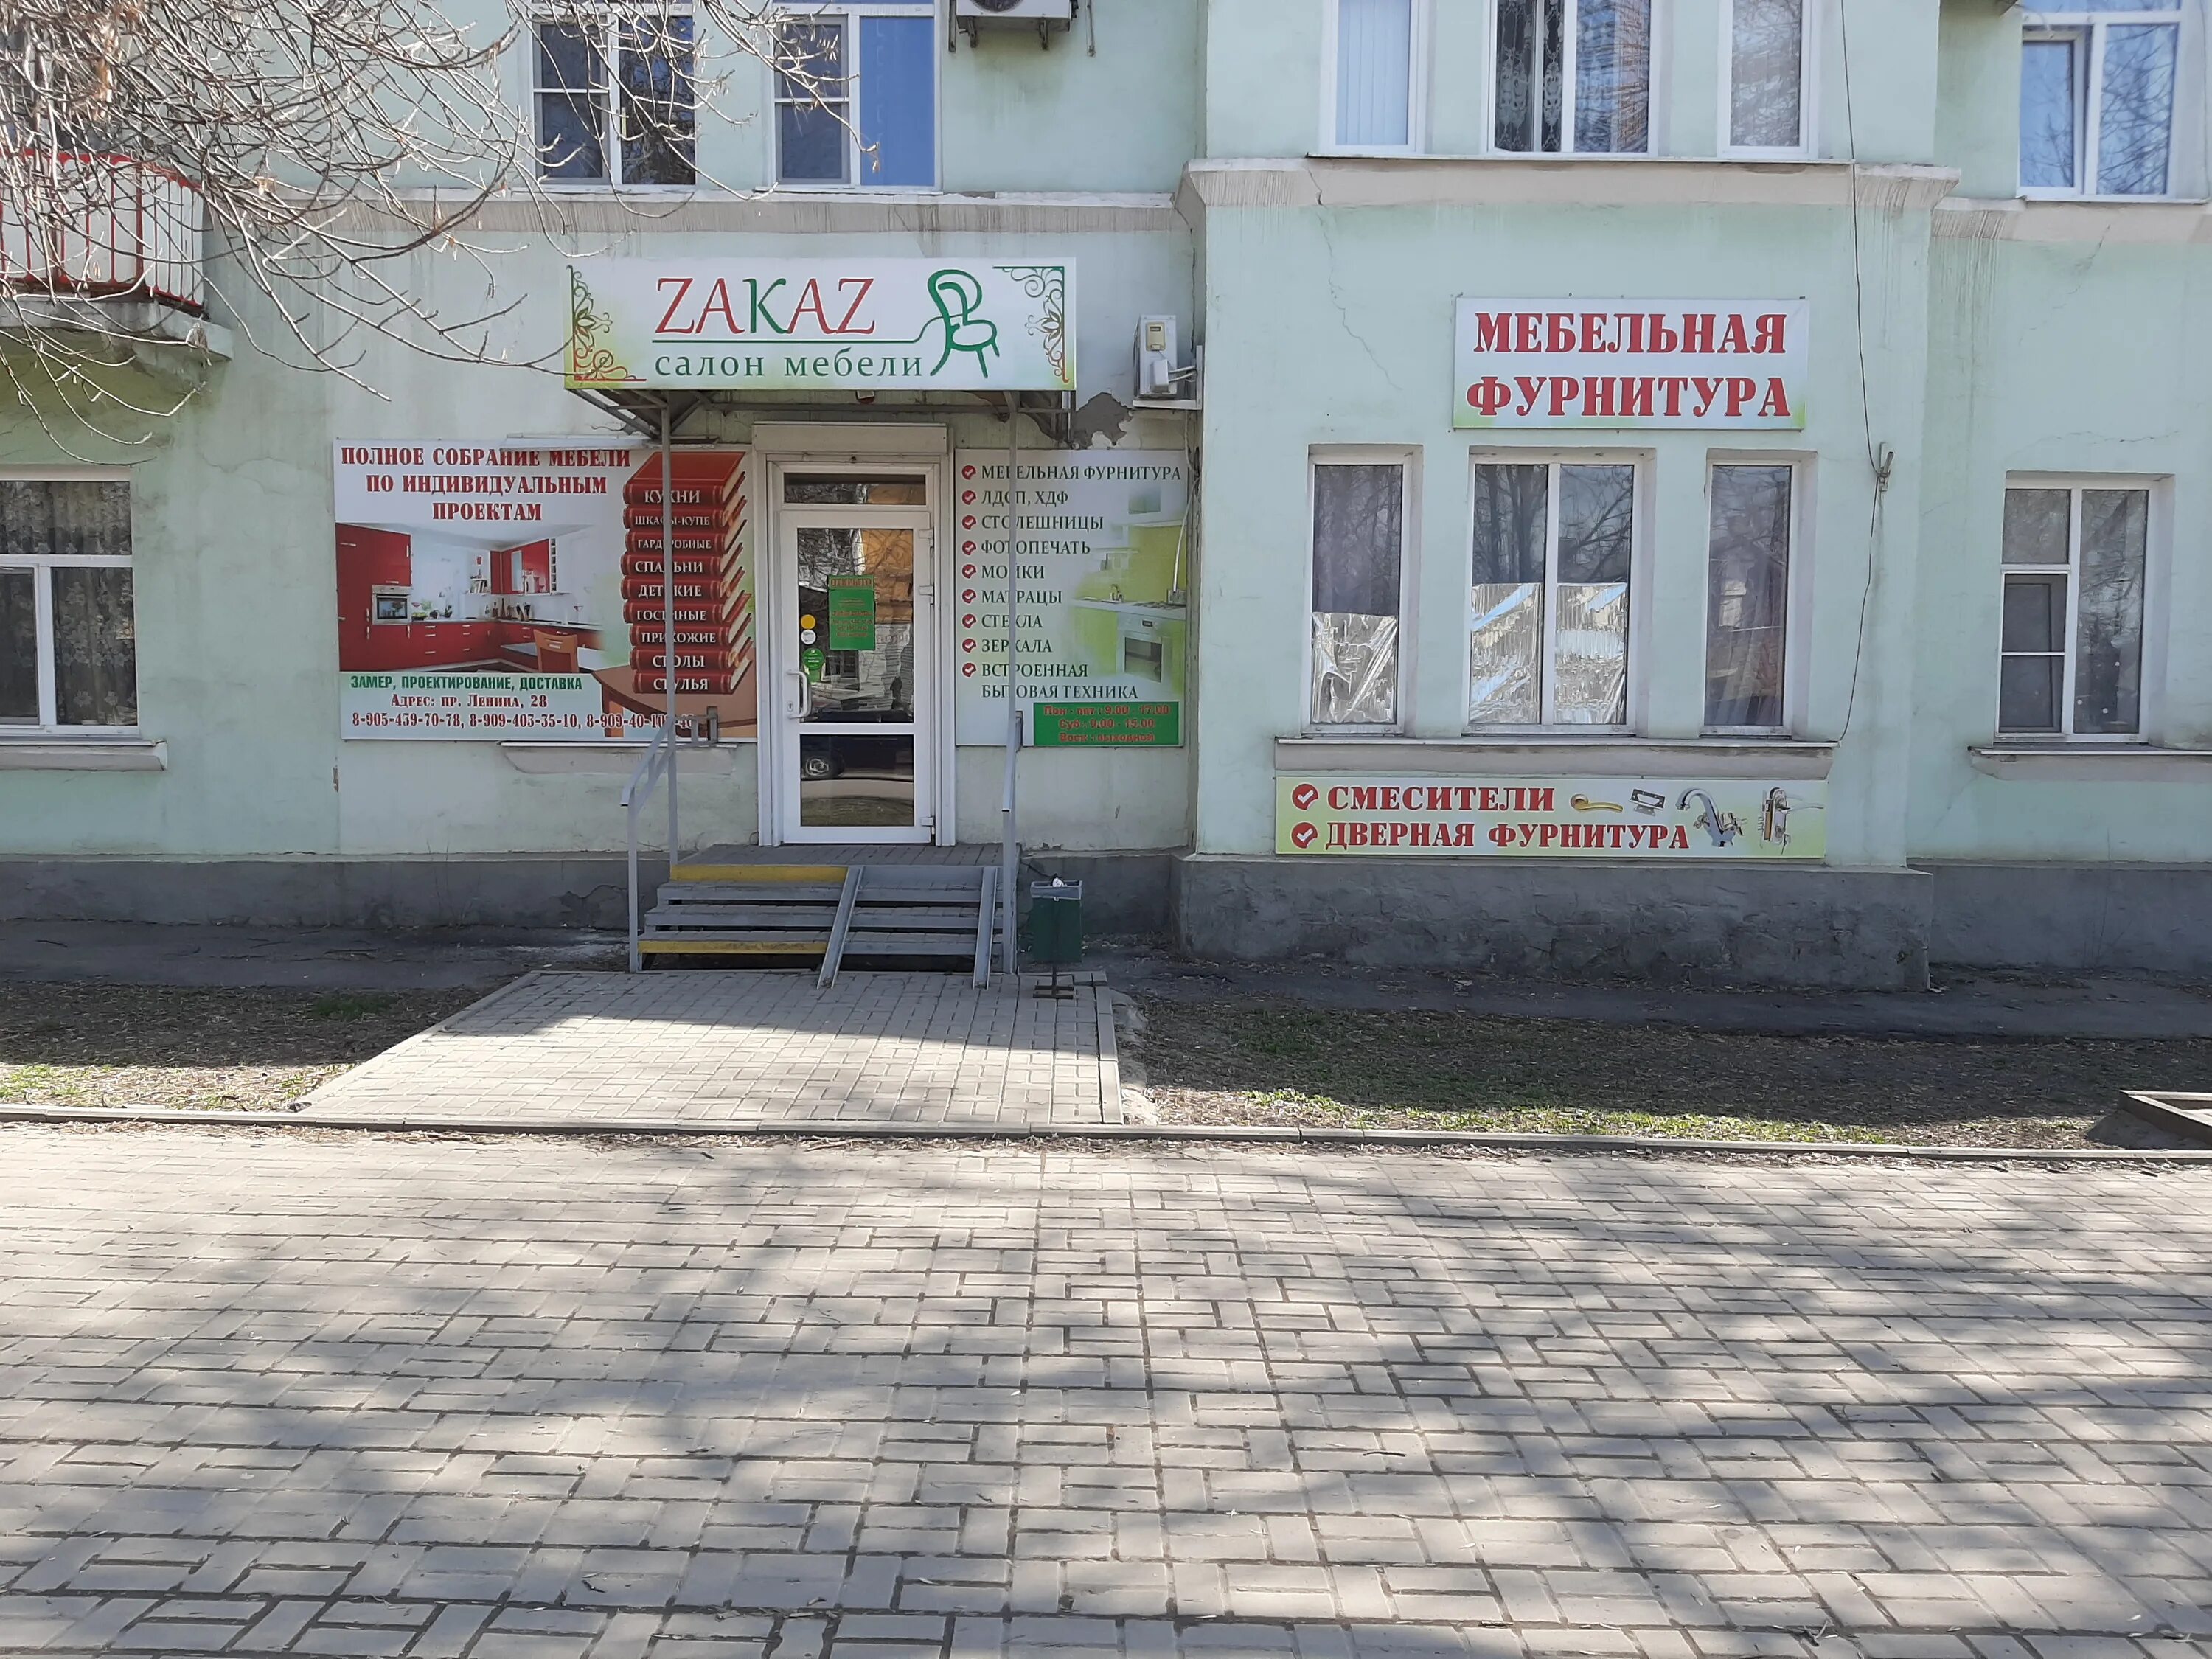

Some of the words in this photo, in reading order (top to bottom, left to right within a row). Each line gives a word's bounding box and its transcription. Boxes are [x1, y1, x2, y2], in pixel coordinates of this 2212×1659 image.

[655, 277, 877, 335] ZAKAZ
[1473, 313, 1787, 354] МЕБЕЛЬНАЯ
[655, 354, 764, 377] салон
[784, 346, 922, 377] мебели
[1467, 376, 1791, 417] ФУРНИТУРА
[341, 447, 424, 466] ПОЛНОЕ
[433, 448, 540, 467] СОБРАНИЕ
[549, 449, 630, 467] МЕБЕЛИ
[1084, 465, 1181, 480] ФУРНИТУРА
[366, 474, 393, 493] ПО
[403, 475, 607, 496] ИНДИВИДУАЛЬНЫМ
[1034, 490, 1068, 507] ХДФ
[433, 502, 541, 521] ПРОЕКТАМ
[981, 515, 1104, 532] СТОЛЕШНИЦЫ
[981, 540, 1091, 554] ФОТОПЕЧАТЬ
[635, 560, 703, 573] СПАЬНИ
[638, 585, 702, 599] ДЕТКИЕ
[981, 590, 1062, 606] МАТРАЦЫ
[350, 675, 397, 691] ЗАМЕР,
[402, 676, 515, 692] ПРОЕКТИРОВАНИЕ,
[519, 677, 582, 691] ДОСТАВКА
[1062, 686, 1138, 699] ТЕХНИКА
[531, 695, 548, 708] 28
[1327, 786, 1555, 812] СМЕСИТЕЛИ
[1325, 822, 1474, 850] ДВЕРНАЯ
[1488, 823, 1690, 850] ФУРНИТУРА
